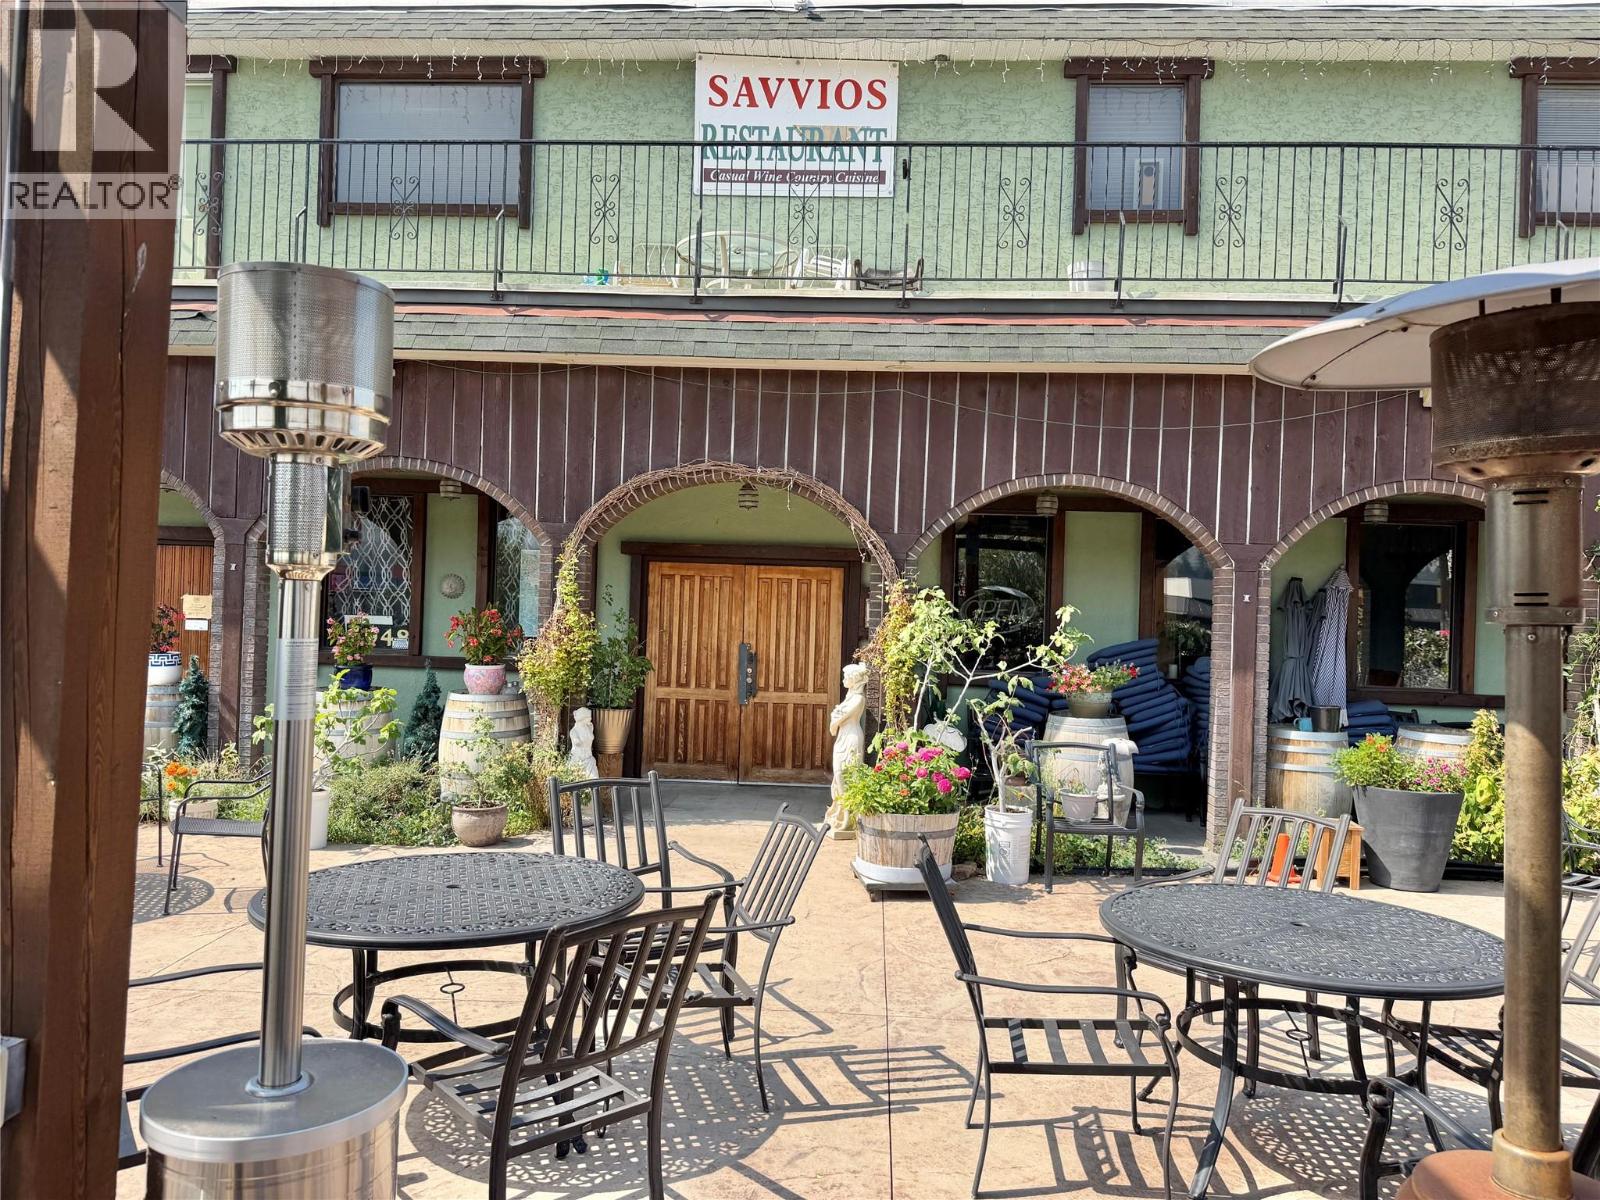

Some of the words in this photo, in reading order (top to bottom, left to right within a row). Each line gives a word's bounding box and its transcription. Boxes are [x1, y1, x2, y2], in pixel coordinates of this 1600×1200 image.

[708, 74, 888, 110] SAVVIOS
[701, 123, 888, 163] RESTAURANT
[710, 169, 750, 182] Casual
[753, 170, 783, 182] Wine
[835, 171, 879, 184] Cuisine
